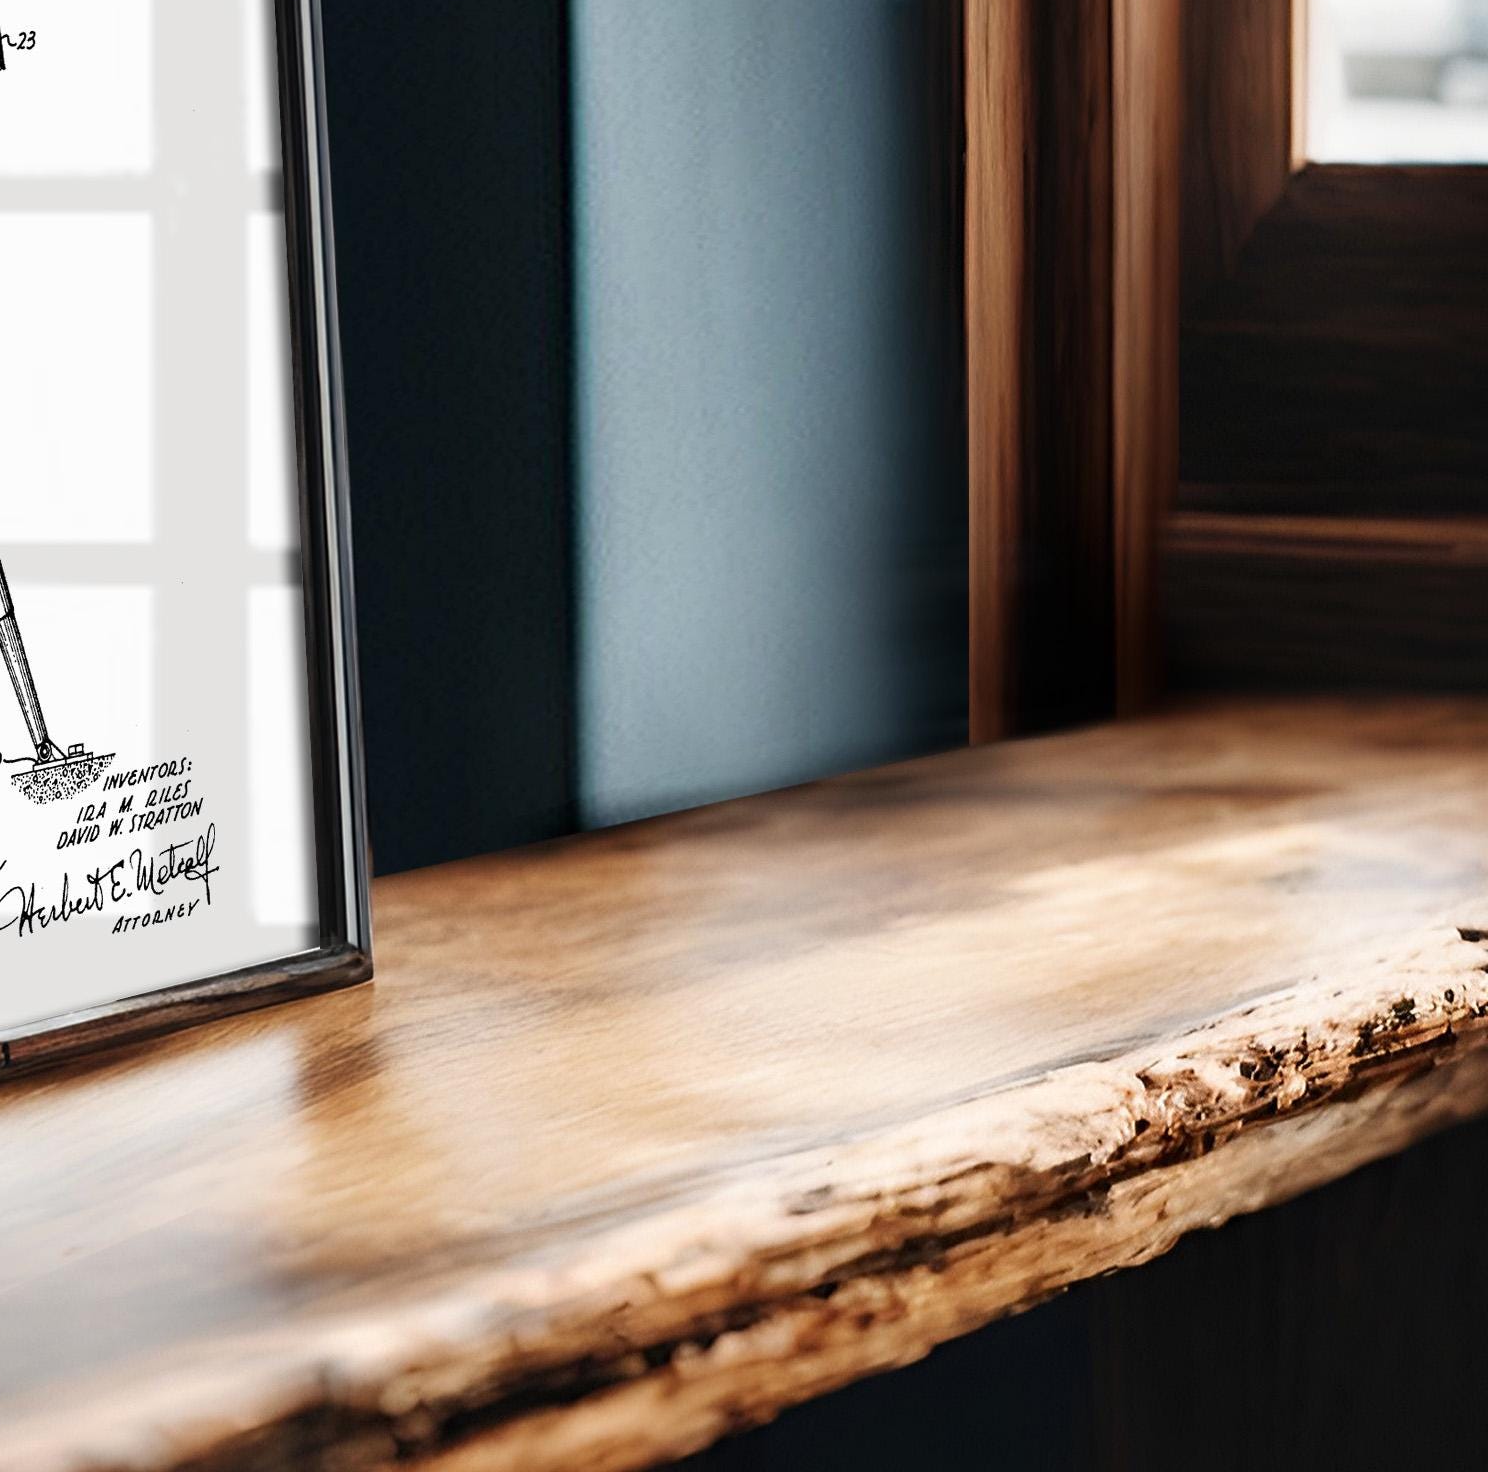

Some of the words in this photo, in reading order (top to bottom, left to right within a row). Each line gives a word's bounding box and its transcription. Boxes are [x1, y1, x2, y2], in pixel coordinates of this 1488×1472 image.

[16, 30, 36, 50] 23
[103, 757, 192, 791] INVENTORS:
[77, 802, 107, 824] IRA
[119, 795, 133, 813] M.
[145, 780, 192, 808] RILES
[56, 824, 101, 850] DAVID
[109, 818, 123, 837] W.
[129, 797, 204, 833] STRATTON
[112, 899, 200, 934] ATTORNEY
